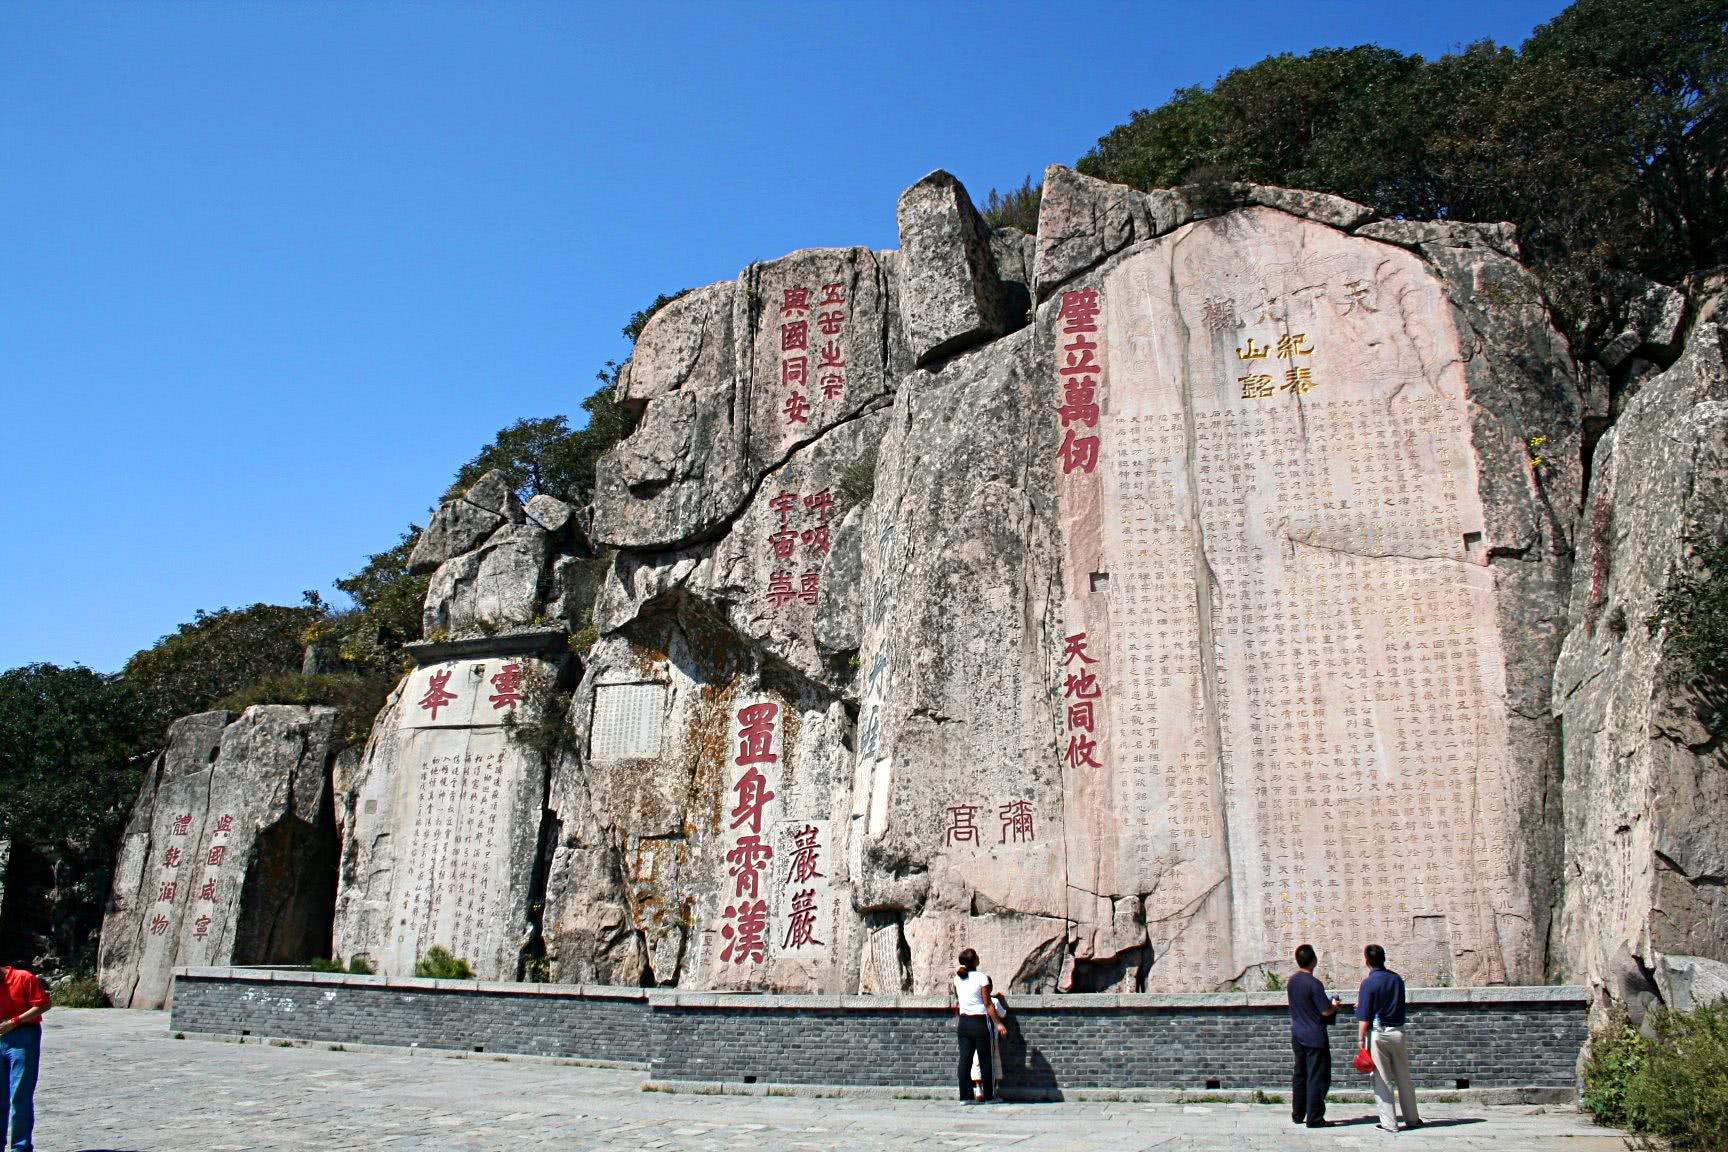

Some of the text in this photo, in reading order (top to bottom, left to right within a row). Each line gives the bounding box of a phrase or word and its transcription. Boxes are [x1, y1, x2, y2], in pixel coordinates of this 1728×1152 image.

[780, 286, 811, 425] 與國同安
[1057, 288, 1103, 476] 壁立萬仞
[720, 702, 779, 966] 置身霄漢
